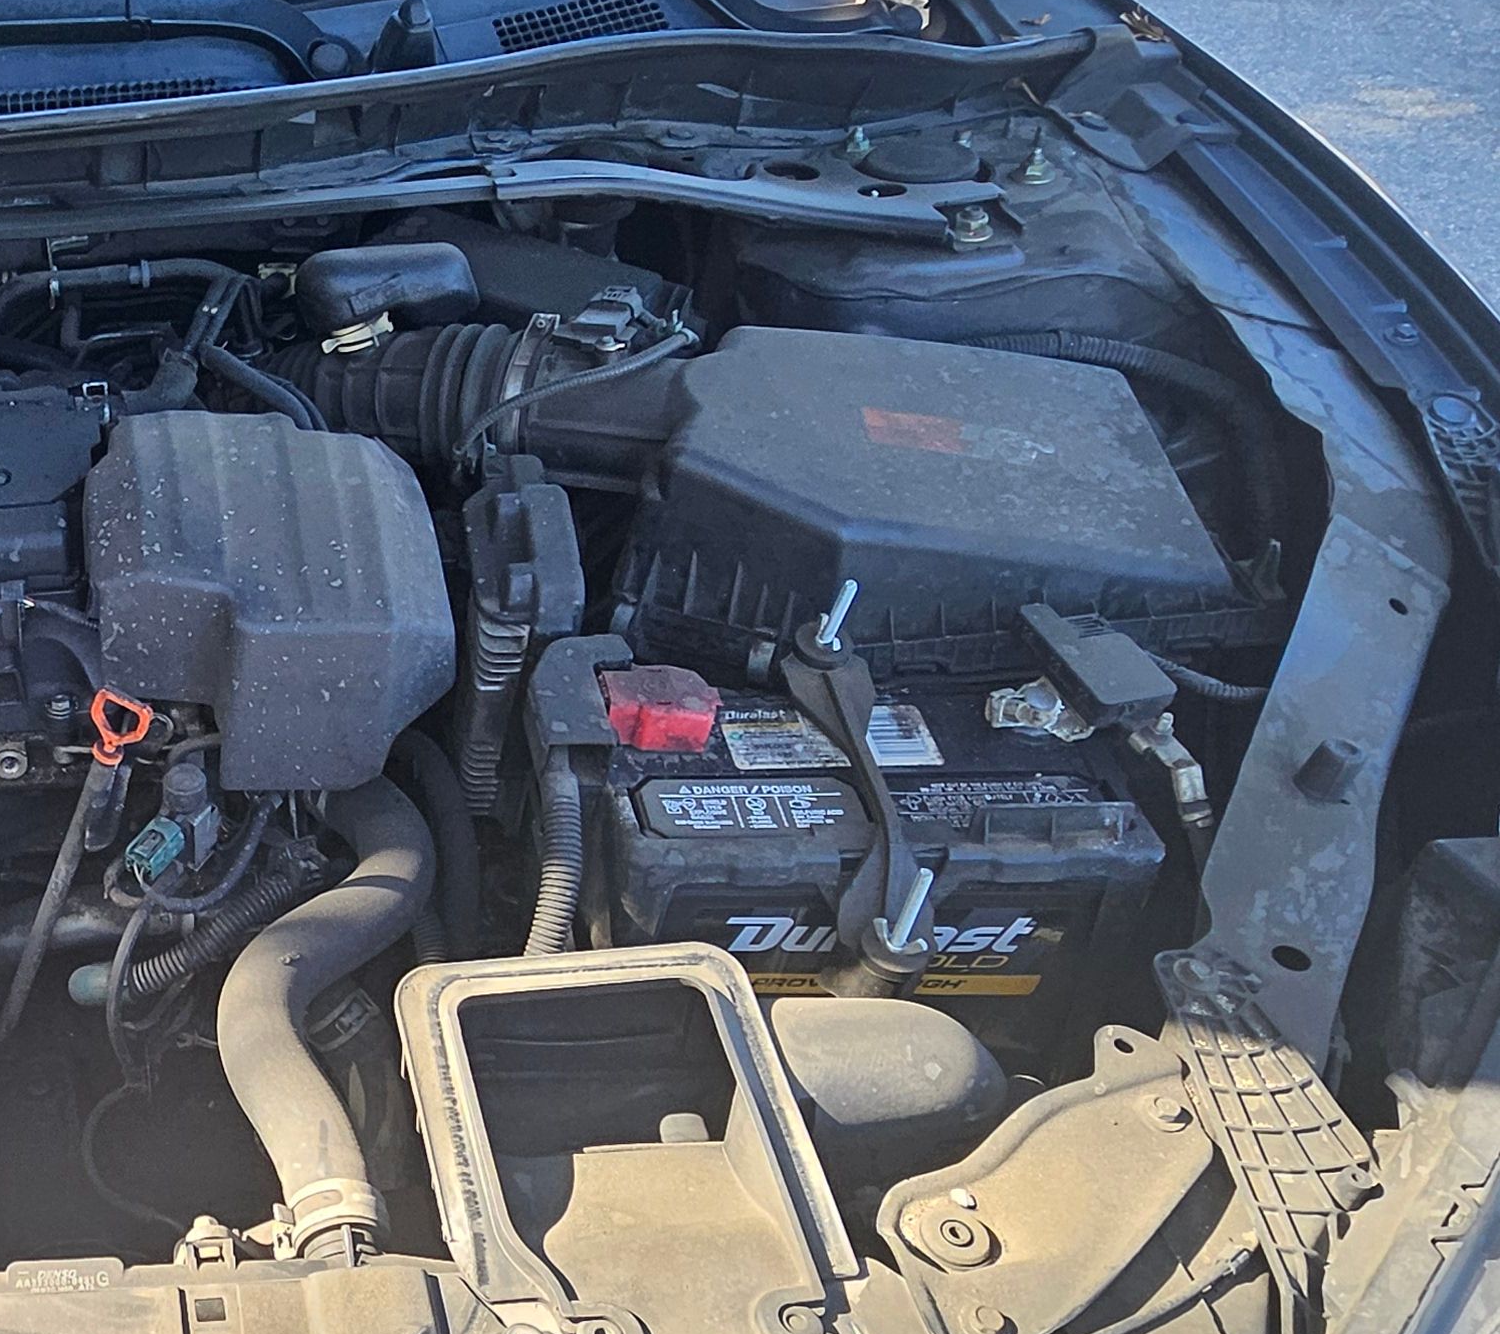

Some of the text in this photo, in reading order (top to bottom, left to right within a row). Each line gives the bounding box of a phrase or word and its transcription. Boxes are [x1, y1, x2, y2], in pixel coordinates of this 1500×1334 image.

[722, 708, 787, 721] Duralast
[692, 785, 749, 795] DANGER
[762, 784, 813, 794] POISON
[927, 954, 1010, 968] OLD
[752, 977, 820, 988] PROV
